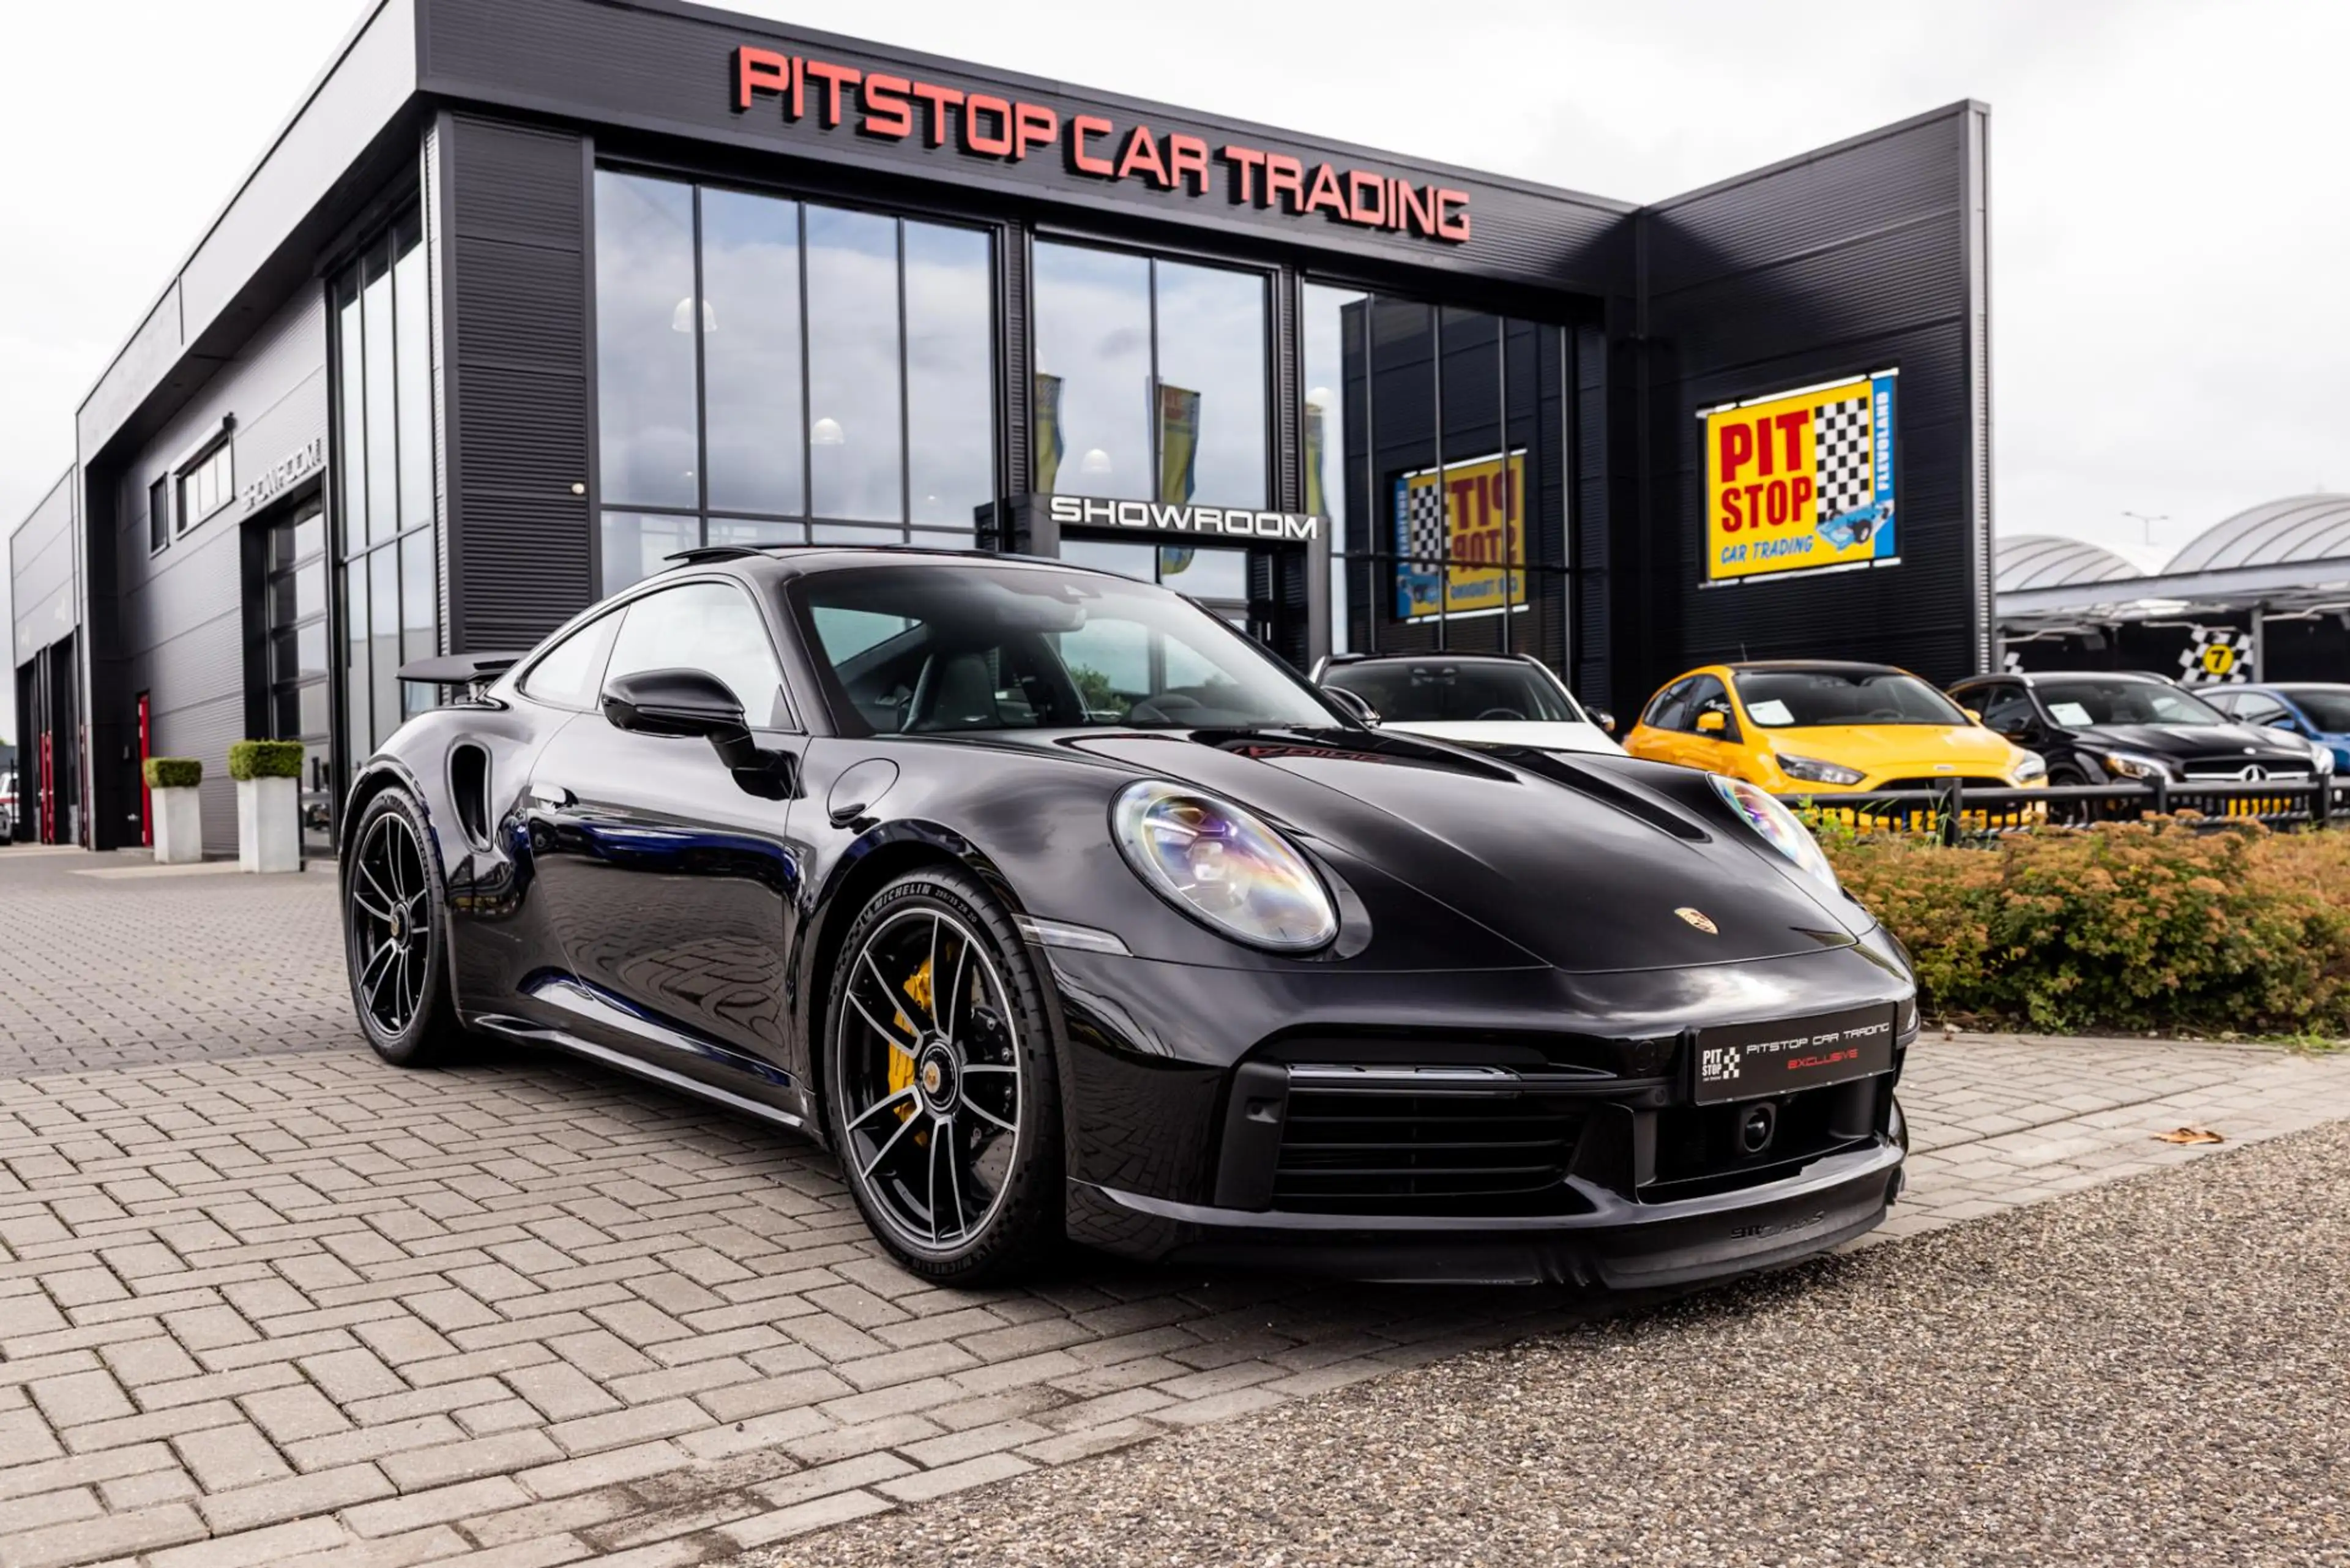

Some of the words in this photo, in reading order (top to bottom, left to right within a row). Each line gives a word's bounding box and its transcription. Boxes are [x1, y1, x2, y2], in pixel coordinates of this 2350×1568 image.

[737, 45, 1058, 159] PITSTOP
[1073, 114, 1208, 193] CAR
[1224, 146, 1469, 240] TRADING
[1720, 409, 1809, 483] PIT
[1050, 496, 1318, 540] SHOWROOM
[1721, 476, 1812, 533] STOP
[1721, 543, 1747, 564] CAR
[1753, 535, 1814, 559] TRADING
[2210, 649, 2226, 670] 7
[874, 883, 931, 911] MICHELIN
[1746, 1037, 1809, 1055] PITSTOP
[1812, 1032, 1840, 1046] CAR
[1843, 1021, 1890, 1039] TRADING
[1702, 1064, 1722, 1077] STOP
[1703, 1048, 1723, 1065] PIT
[1787, 1048, 1859, 1070] EXCLUSIVE
